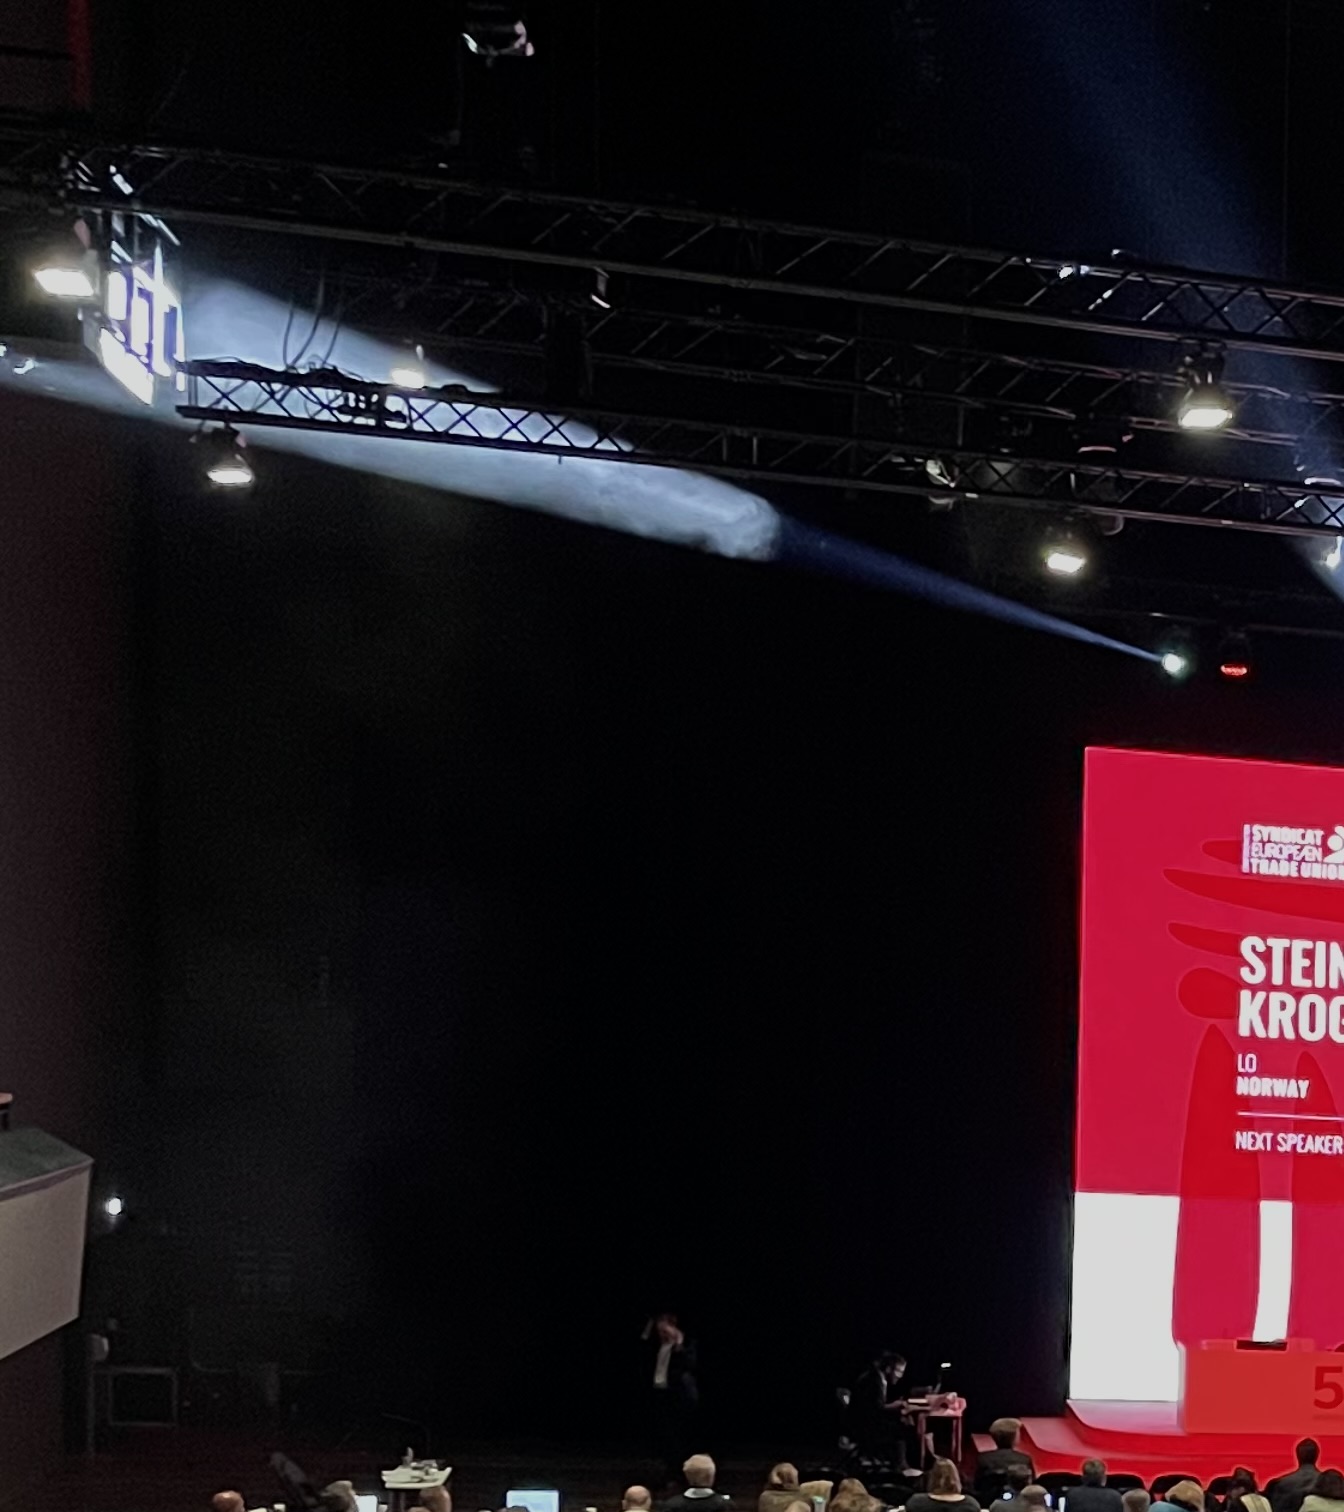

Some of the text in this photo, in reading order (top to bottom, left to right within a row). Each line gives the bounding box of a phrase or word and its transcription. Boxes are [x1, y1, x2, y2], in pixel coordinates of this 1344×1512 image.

[1237, 1053, 1257, 1073] LO
[1236, 1076, 1309, 1099] NORWAY
[1235, 1130, 1273, 1152] NEXT
